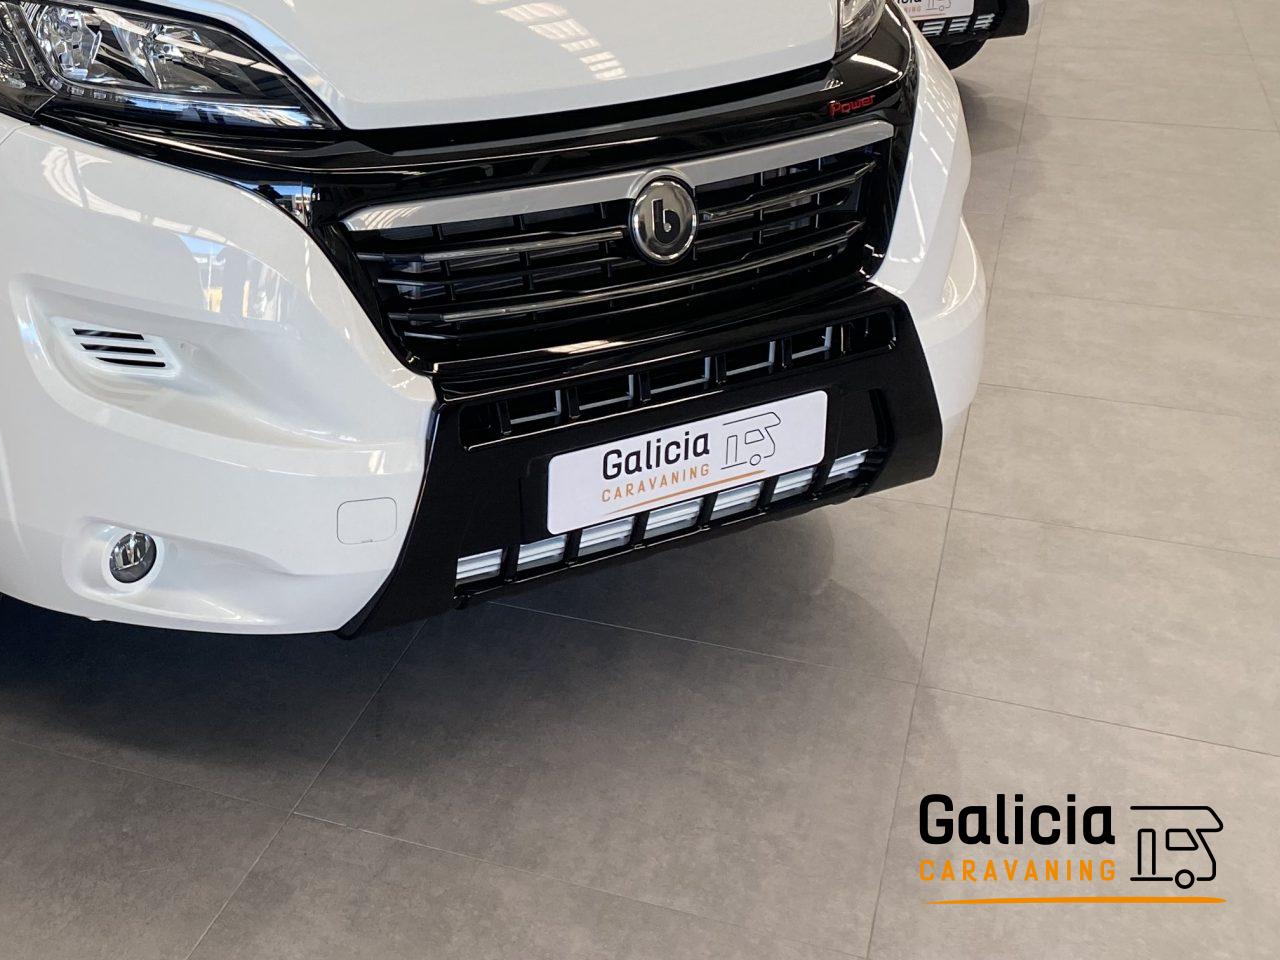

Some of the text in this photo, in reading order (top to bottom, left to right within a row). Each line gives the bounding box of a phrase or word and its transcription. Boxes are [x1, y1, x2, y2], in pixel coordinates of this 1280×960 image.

[829, 95, 875, 118] Power
[602, 430, 710, 480] Galicia
[601, 463, 710, 503] CARAVANING
